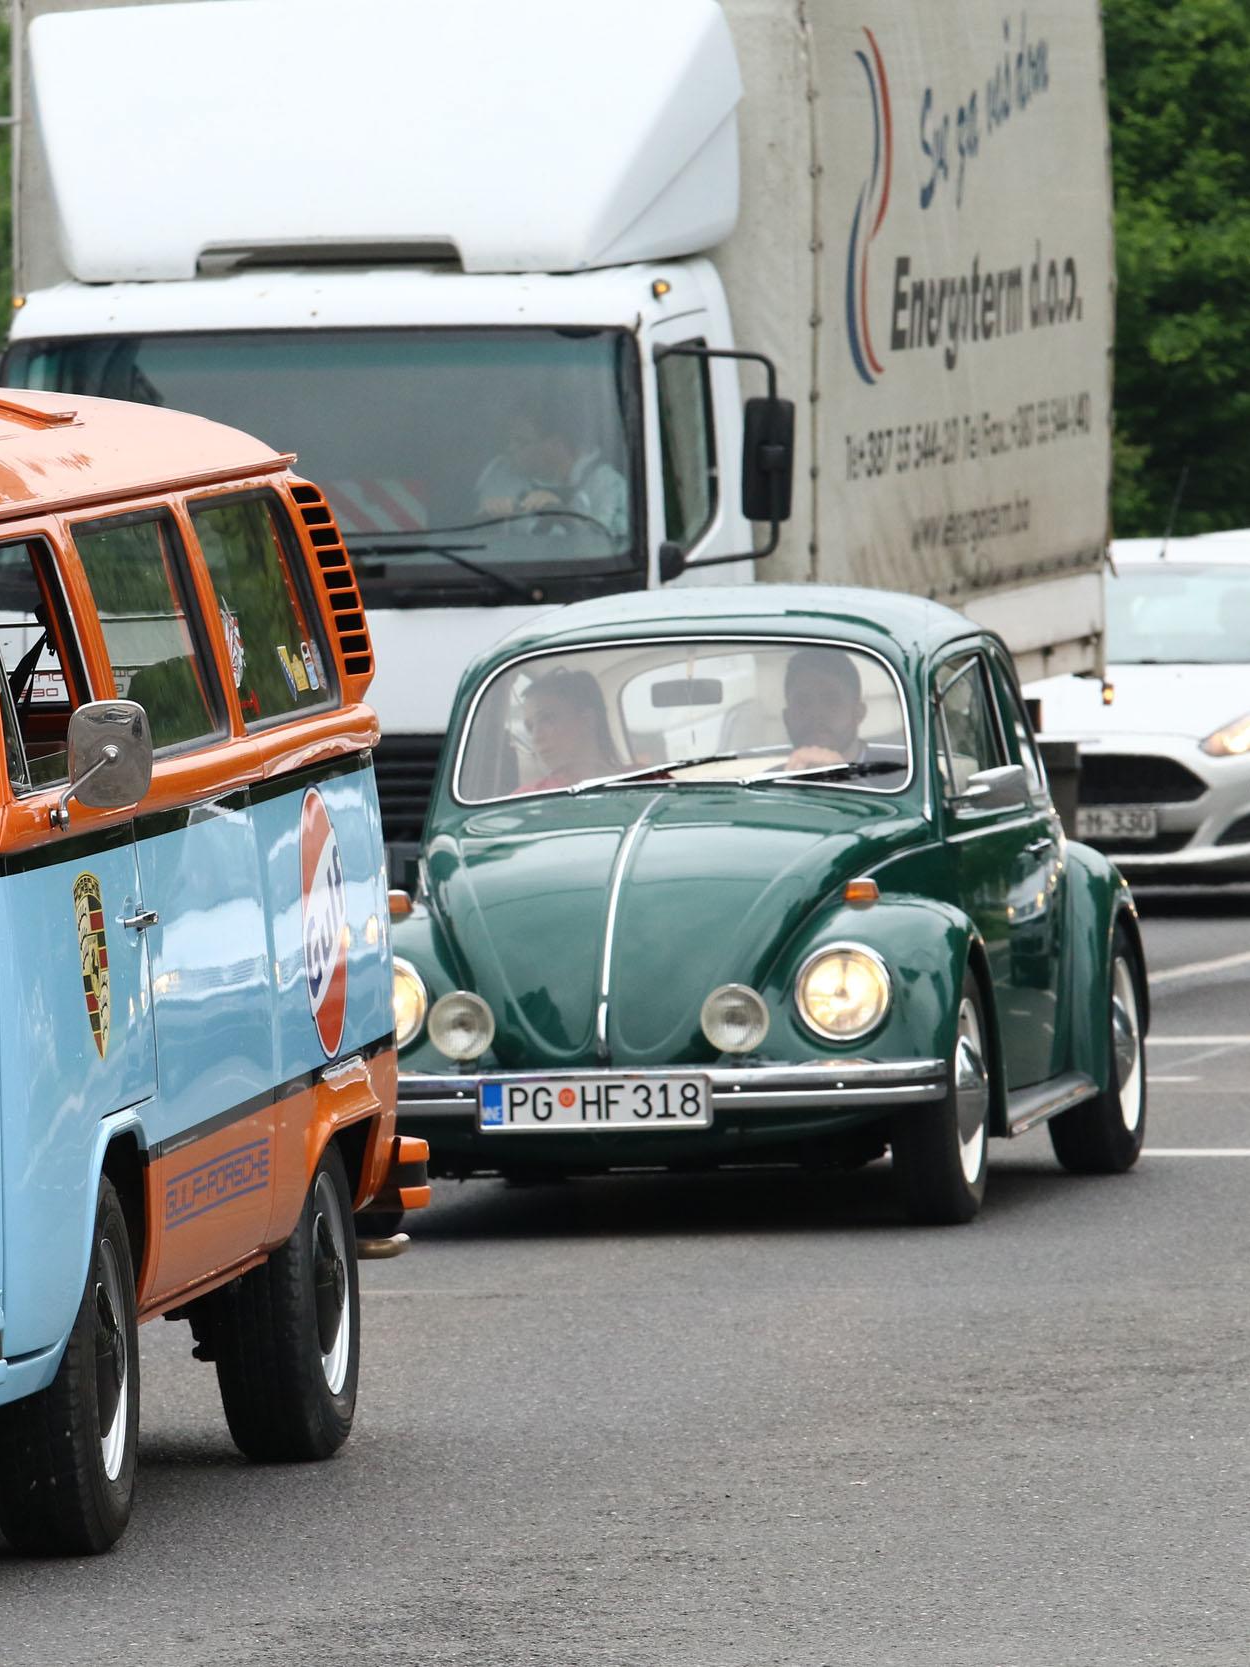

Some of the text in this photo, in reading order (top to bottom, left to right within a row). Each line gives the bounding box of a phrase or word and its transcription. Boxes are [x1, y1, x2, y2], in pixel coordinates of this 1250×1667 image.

[890, 252, 1024, 372] Energoterm
[508, 1083, 700, 1122] PG HF 318
